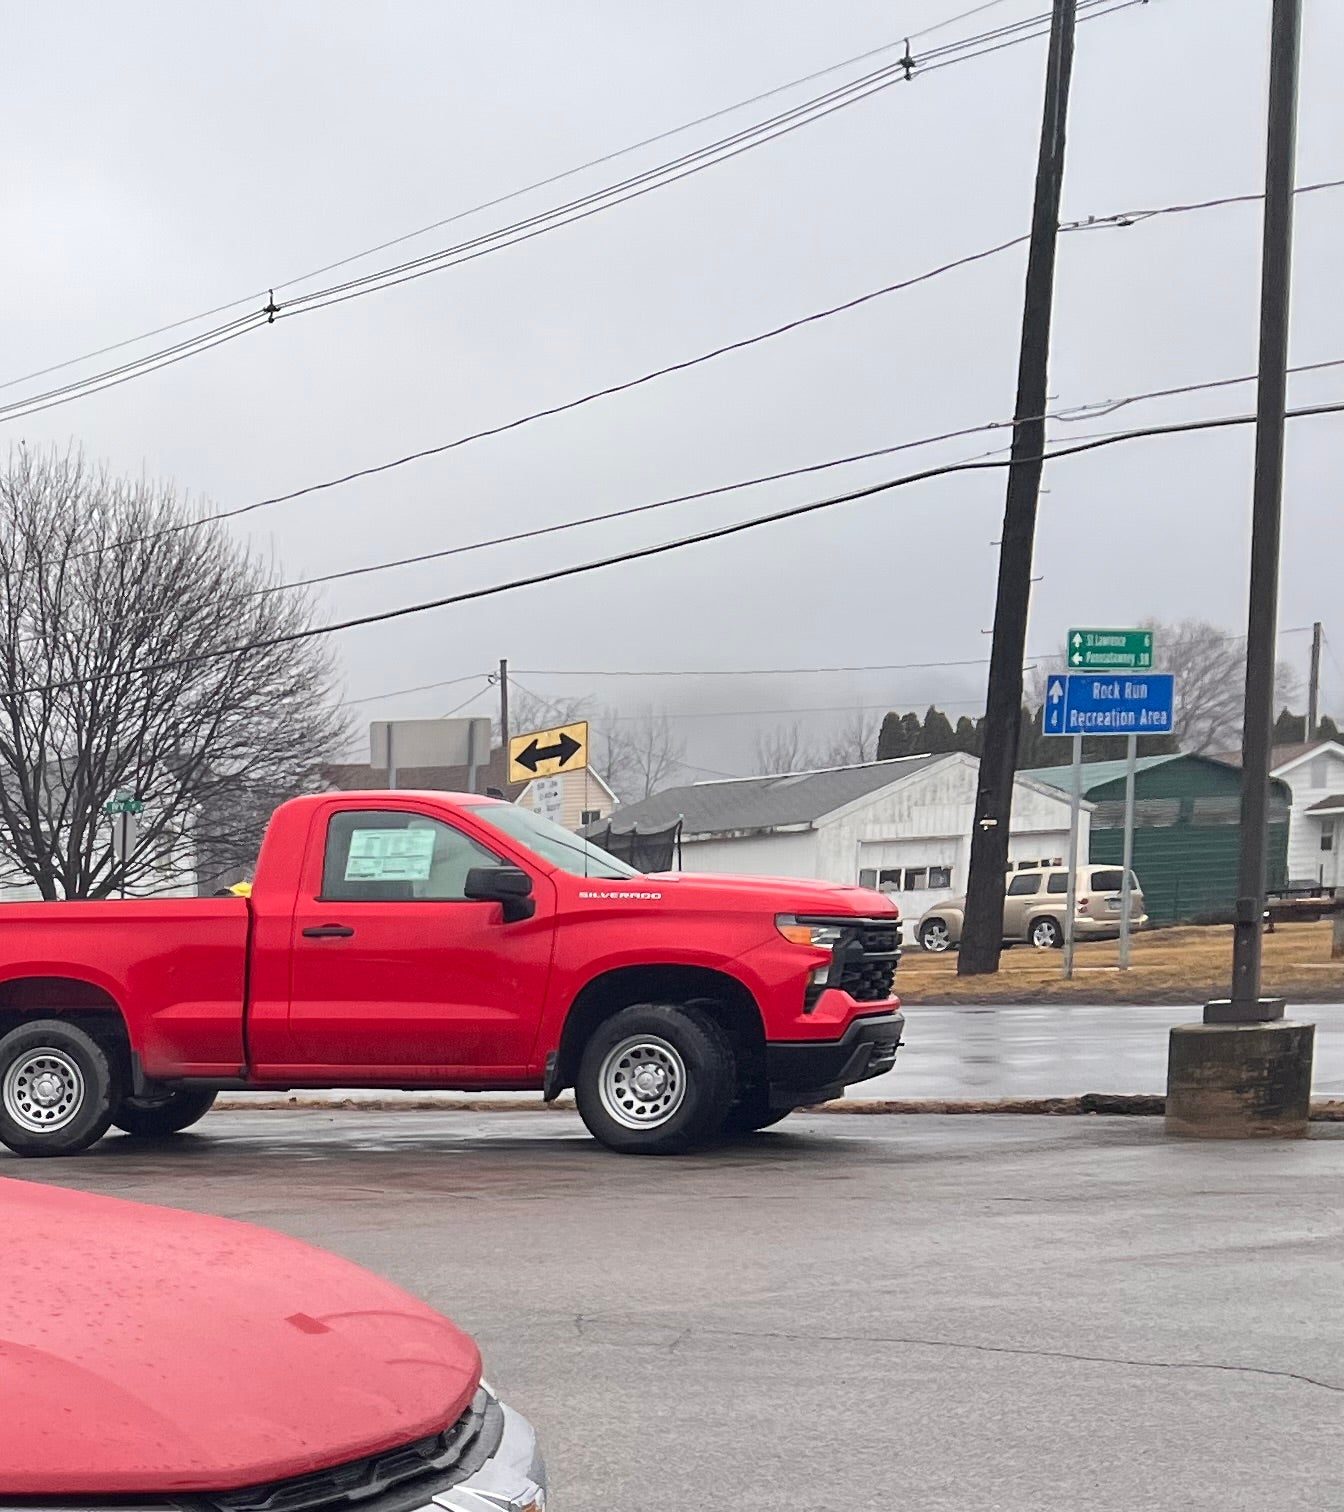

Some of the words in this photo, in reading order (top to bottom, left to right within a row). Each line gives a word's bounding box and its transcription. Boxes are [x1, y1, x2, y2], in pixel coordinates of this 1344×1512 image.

[1093, 681, 1121, 699] Rock
[1125, 681, 1148, 699] Run
[1051, 709, 1058, 727] 4
[1070, 707, 1135, 727] Recreation
[1140, 708, 1168, 725] Area
[578, 891, 662, 900] SILVERADO
